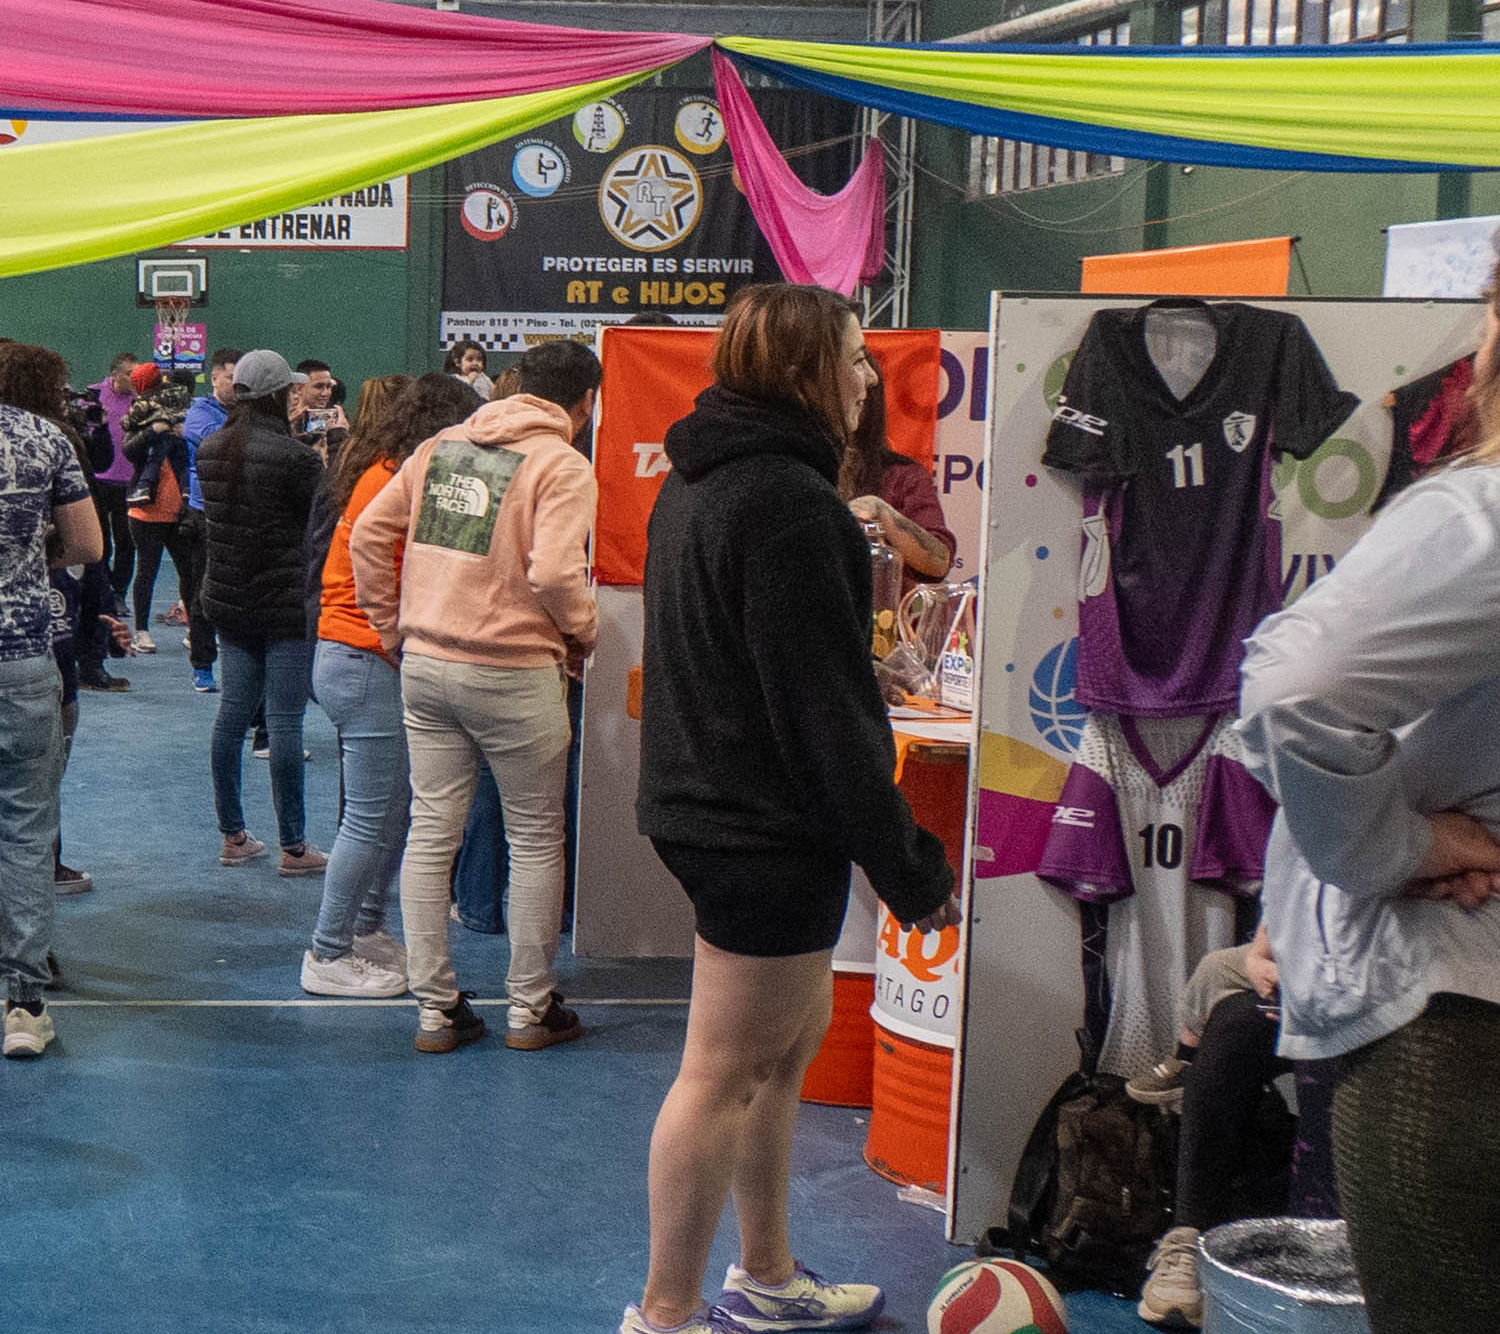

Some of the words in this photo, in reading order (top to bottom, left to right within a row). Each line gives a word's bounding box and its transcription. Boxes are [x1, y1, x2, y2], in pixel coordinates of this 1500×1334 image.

[341, 182, 393, 208] NADA
[239, 214, 352, 241] ENTRENAR
[542, 256, 647, 273] PROTEGER
[653, 257, 677, 273] ES
[683, 258, 754, 274] SERVIR
[567, 280, 603, 304] RT
[612, 283, 630, 304] e
[639, 281, 726, 305] HIJOS
[447, 318, 486, 327] Pasteur
[489, 318, 508, 327] 818
[527, 318, 548, 327] Piso
[559, 319, 577, 327] Tel.
[1166, 443, 1205, 488] 11
[429, 482, 473, 501] NORTH
[450, 473, 472, 489] THE
[436, 497, 470, 513] FACE
[1138, 823, 1184, 870] 10
